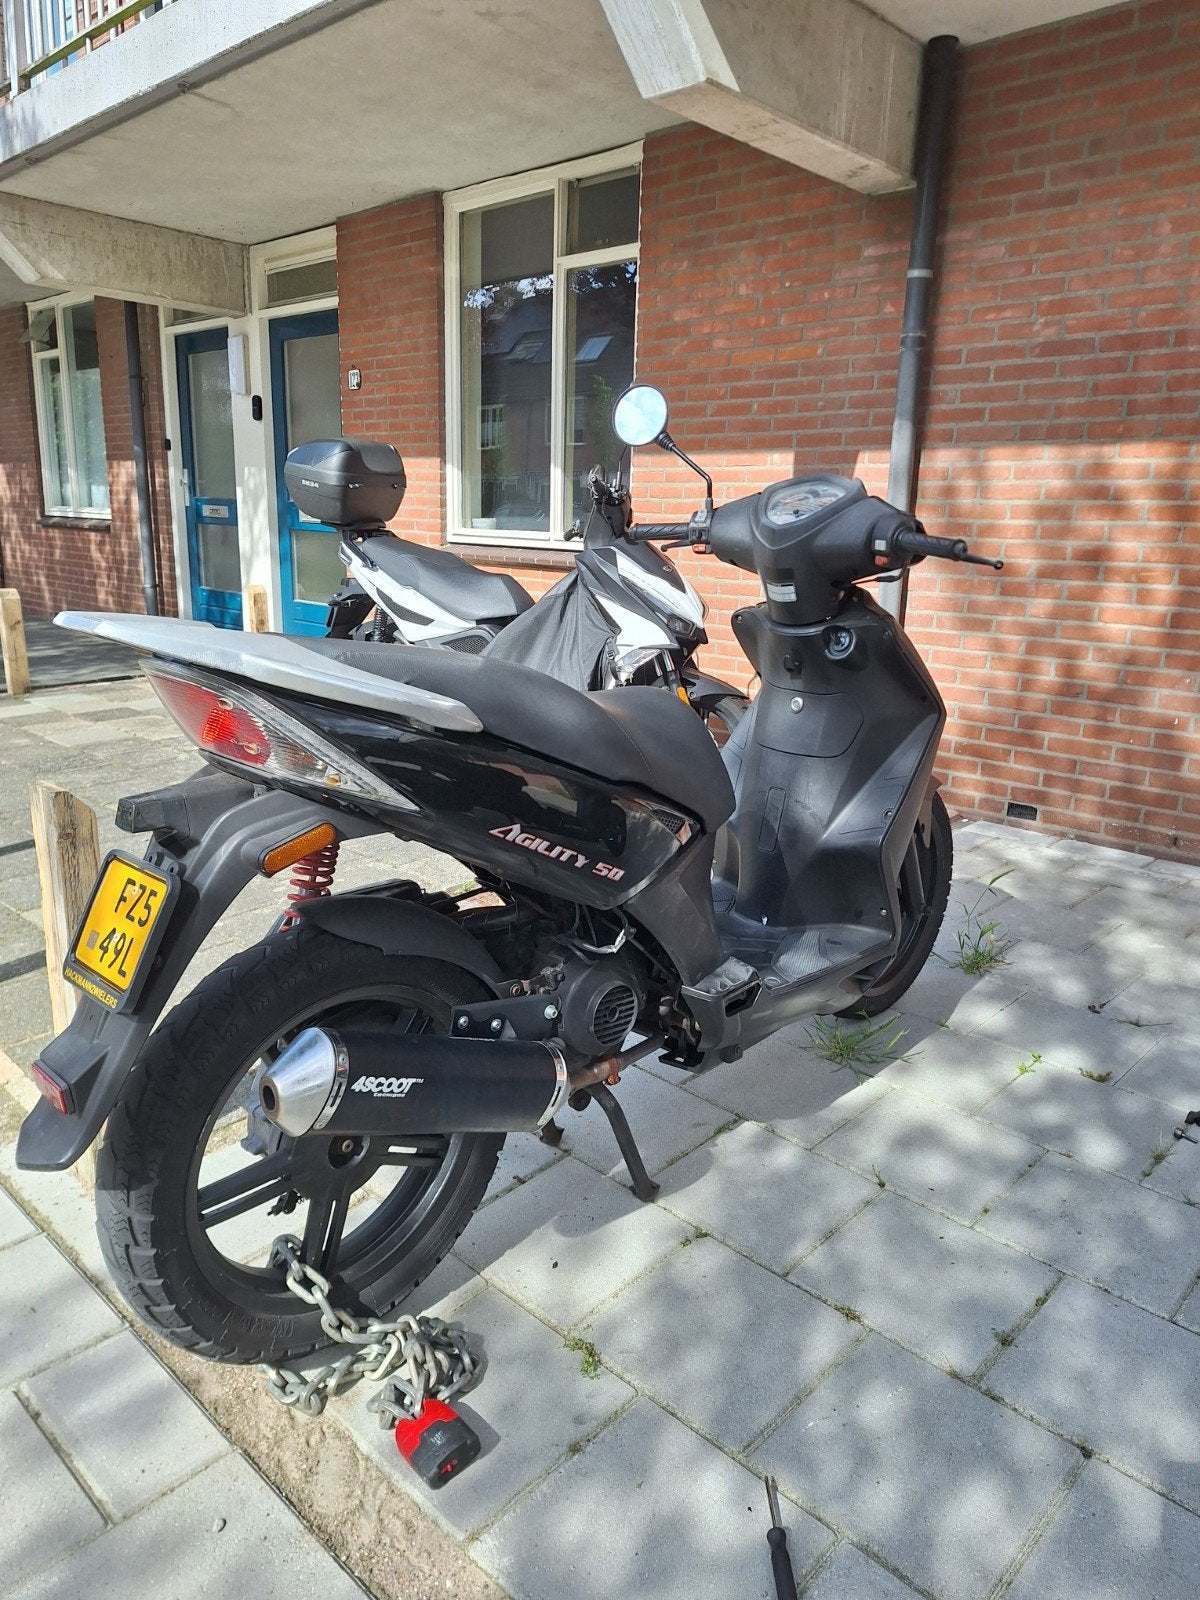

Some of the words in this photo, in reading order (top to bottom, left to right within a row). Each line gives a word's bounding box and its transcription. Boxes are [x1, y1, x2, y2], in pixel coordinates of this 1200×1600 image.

[488, 823, 592, 869] AGILITY
[592, 861, 626, 882] 50
[114, 877, 159, 928] FZ5
[98, 926, 136, 979] 49L
